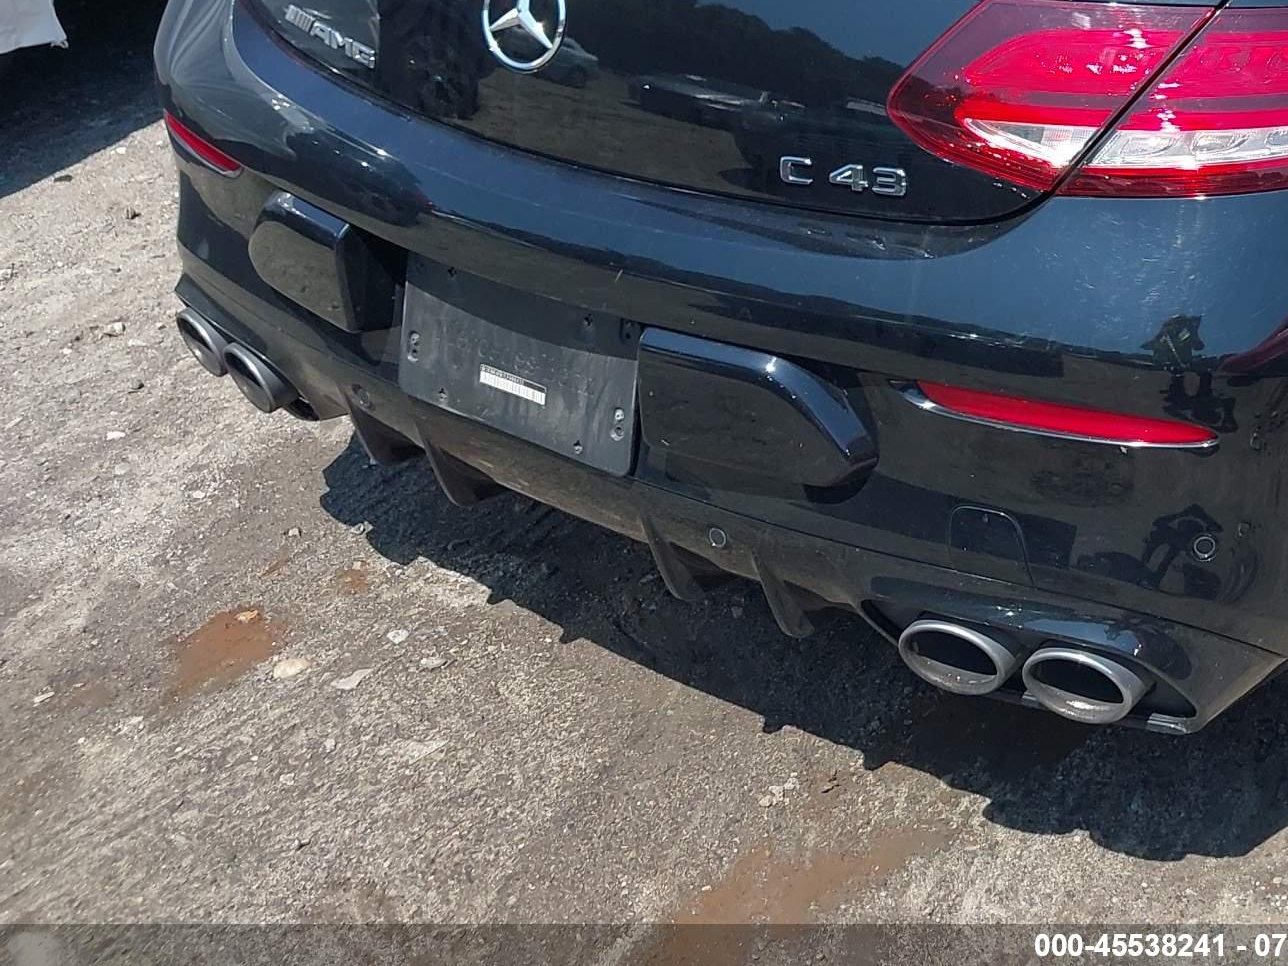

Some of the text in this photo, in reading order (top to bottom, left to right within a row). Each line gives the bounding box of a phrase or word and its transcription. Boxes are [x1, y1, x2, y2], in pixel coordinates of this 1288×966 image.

[307, 20, 376, 69] AMG
[779, 155, 908, 197] C 43
